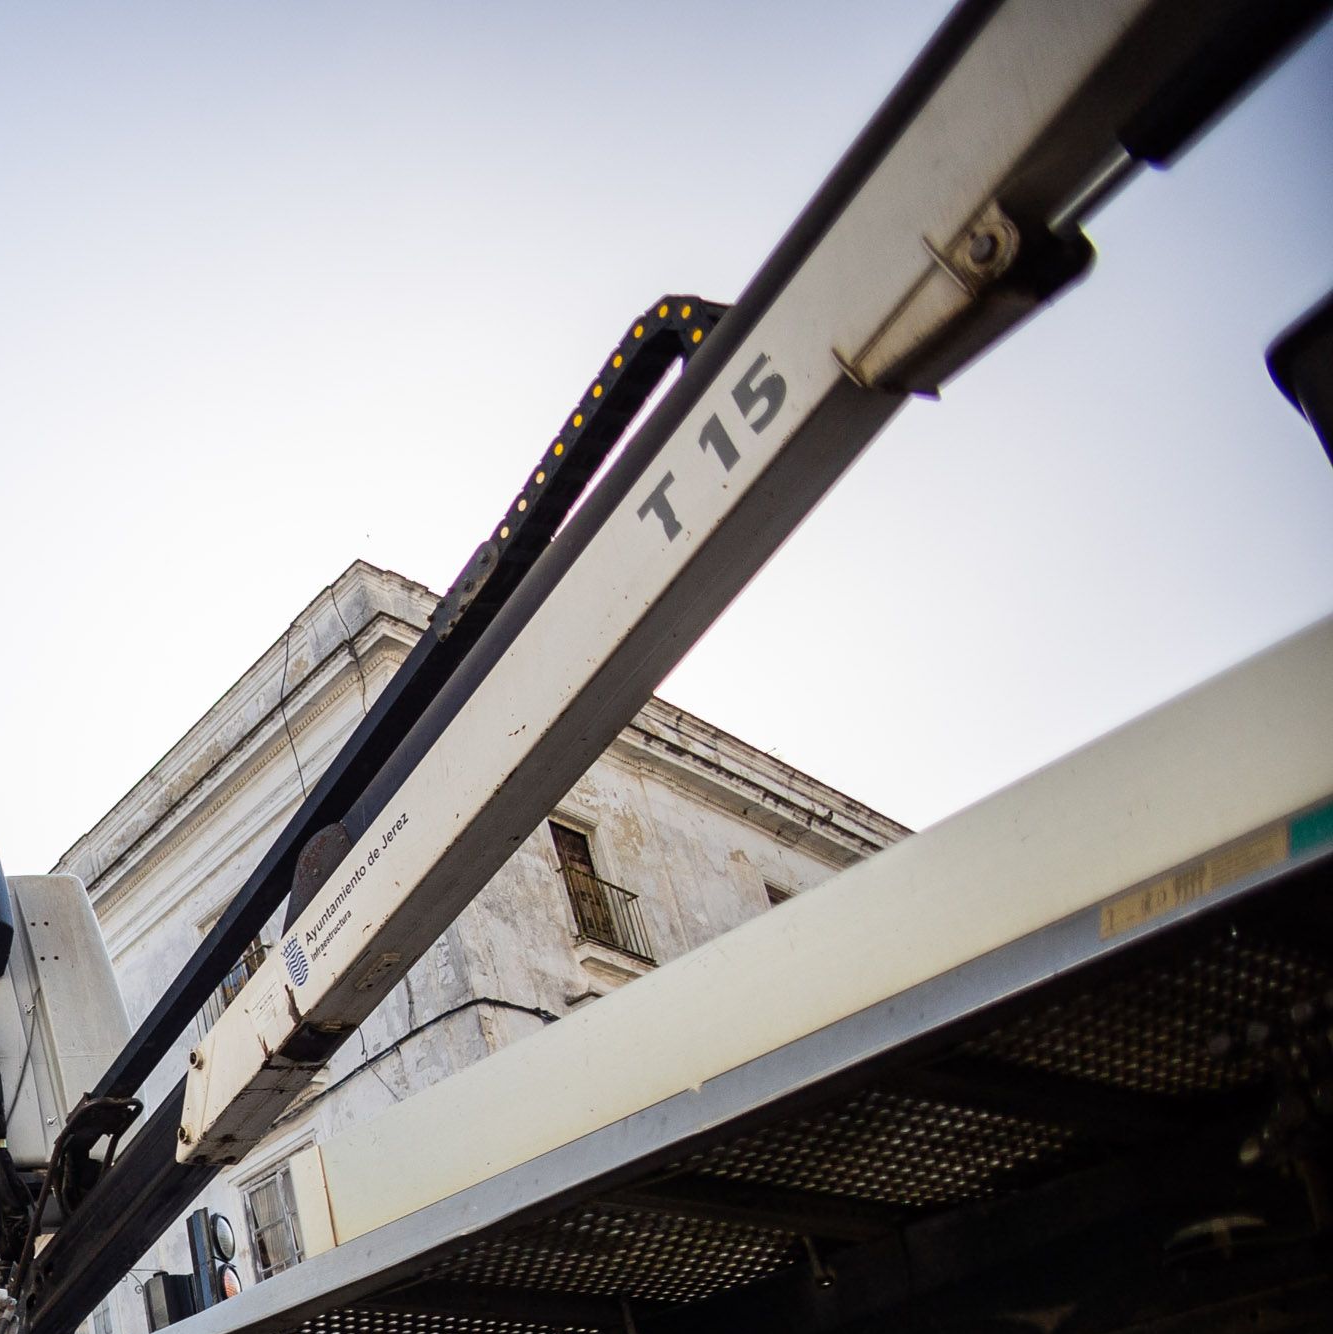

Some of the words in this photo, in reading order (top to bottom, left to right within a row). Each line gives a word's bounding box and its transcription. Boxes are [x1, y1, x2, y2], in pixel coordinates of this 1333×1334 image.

[637, 470, 683, 543] T
[698, 352, 787, 473] 15
[305, 866, 367, 946] Ayuntamiento
[367, 848, 381, 867] de
[382, 812, 410, 849] Jerez
